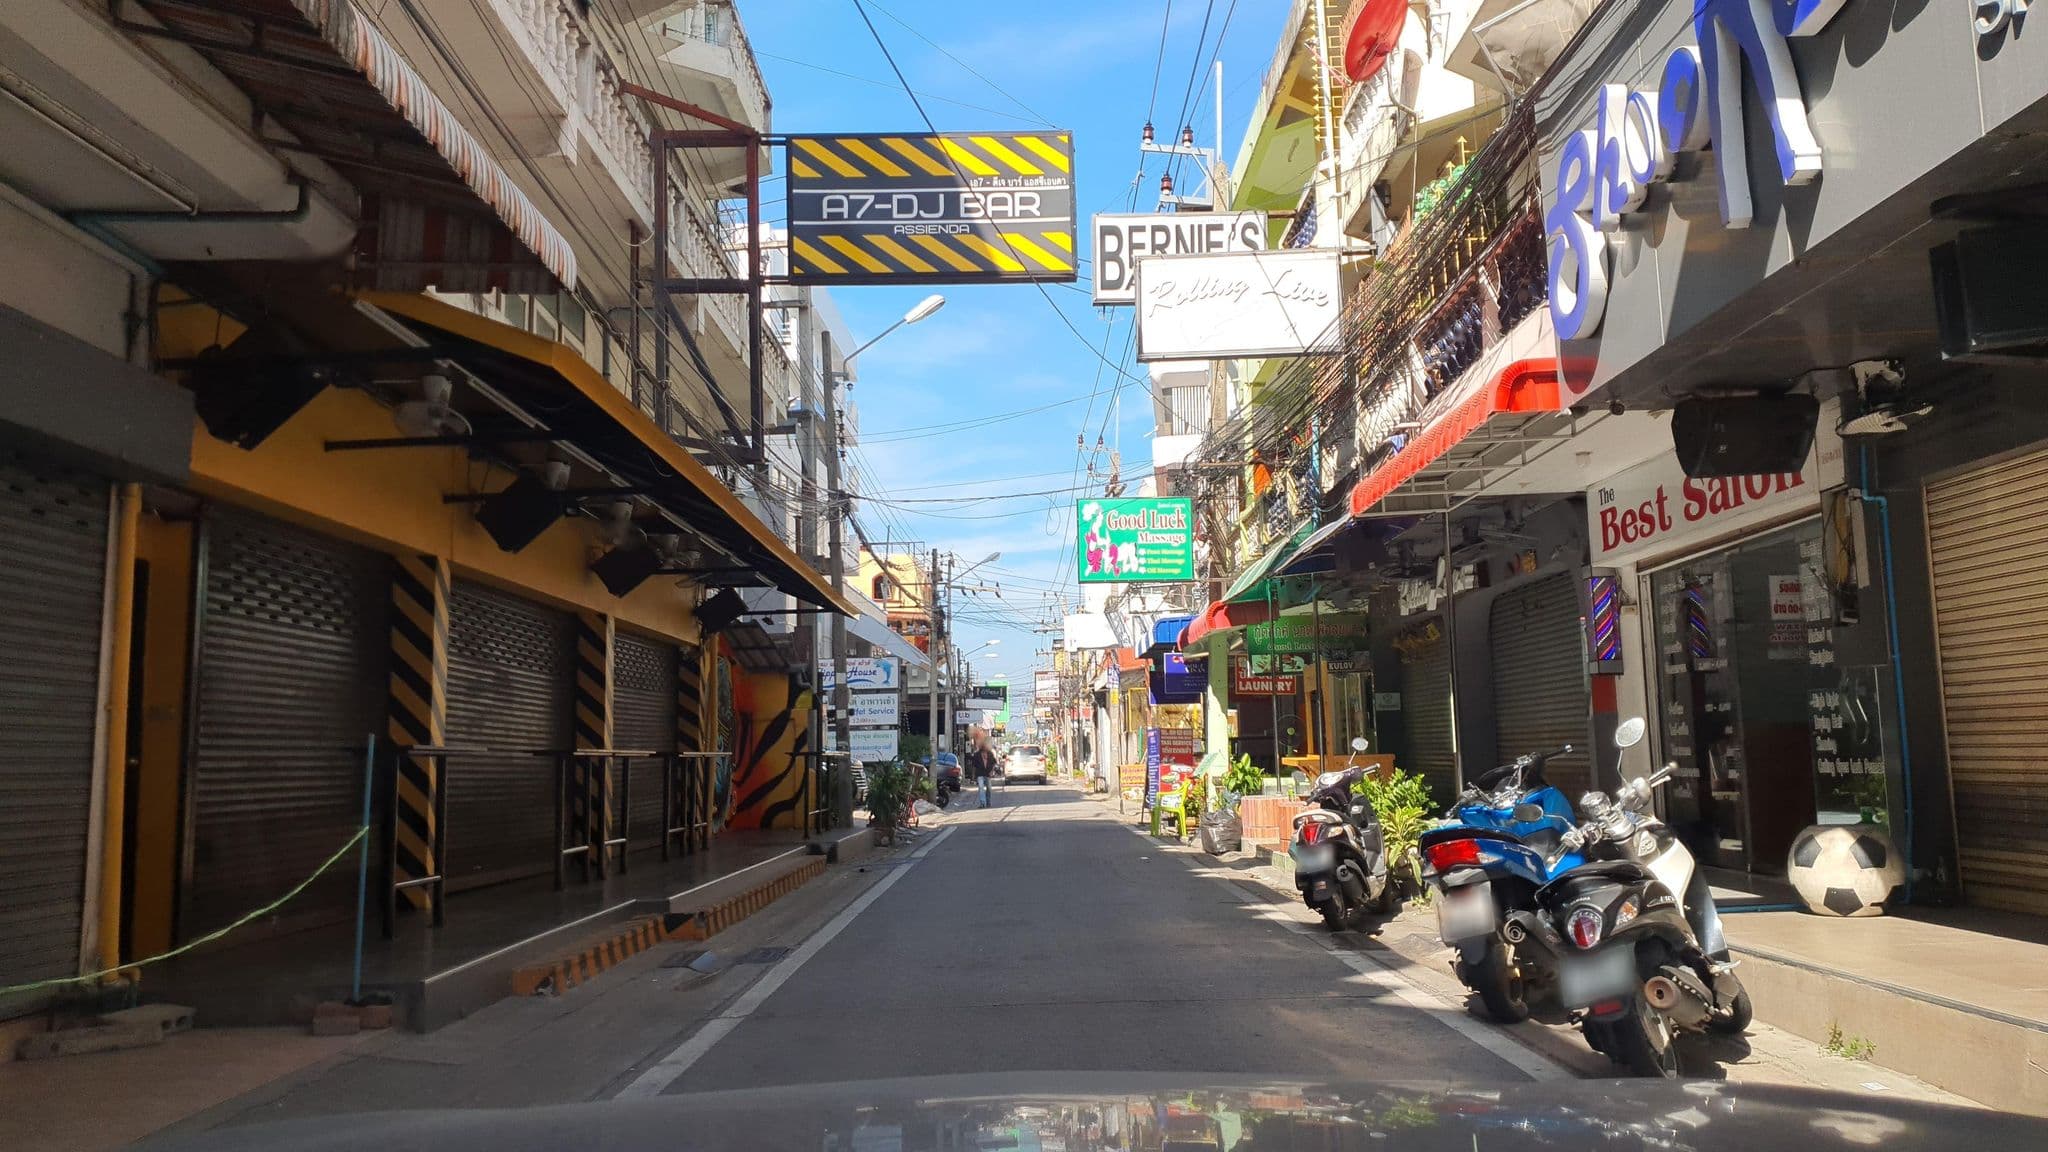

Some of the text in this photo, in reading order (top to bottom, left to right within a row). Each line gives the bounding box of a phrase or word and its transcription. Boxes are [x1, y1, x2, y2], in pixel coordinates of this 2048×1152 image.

[822, 191, 1041, 219] A7-DJ BAR
[894, 224, 970, 234] ASSIENDA
[1099, 221, 1261, 291] BERNIE'S
[1149, 276, 1251, 318] Rolling
[1262, 269, 1330, 307] Live
[1598, 487, 1616, 506] The
[1107, 508, 1187, 530] Good Luck
[1600, 484, 1673, 552] Best
[1139, 532, 1186, 547] Massage
[847, 667, 877, 679] House
[1328, 662, 1354, 670] KULOV
[1238, 681, 1292, 691] LAUNRY
